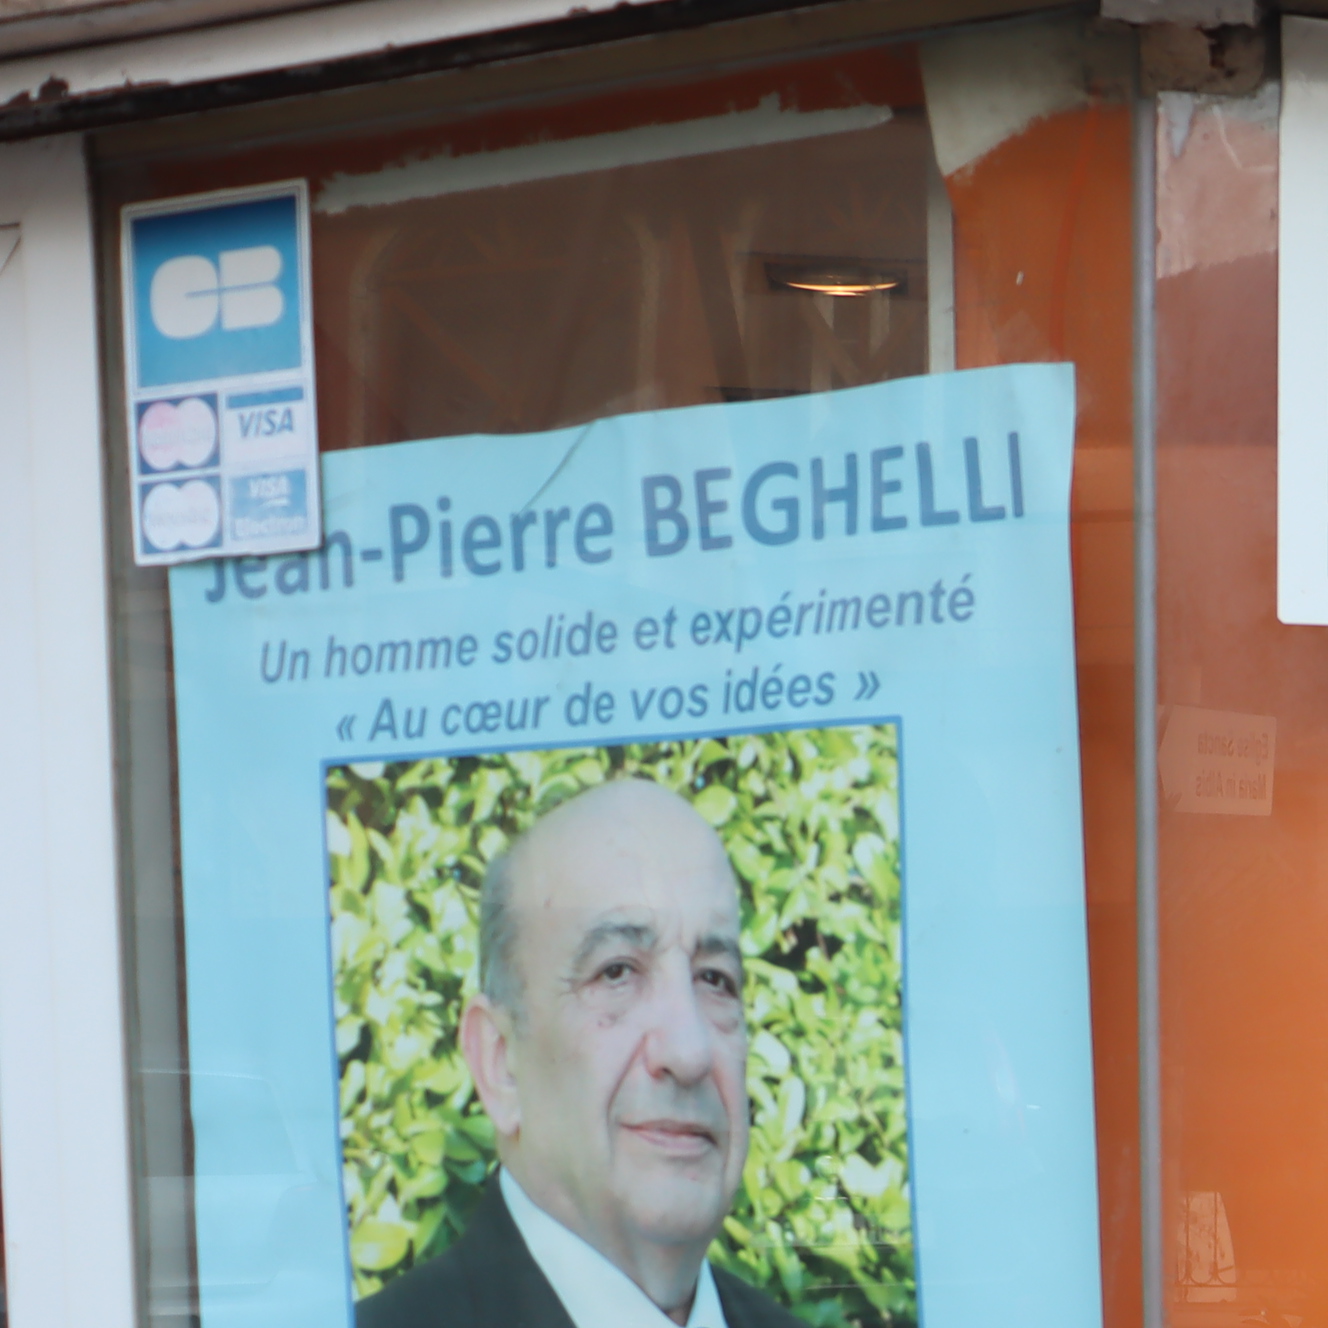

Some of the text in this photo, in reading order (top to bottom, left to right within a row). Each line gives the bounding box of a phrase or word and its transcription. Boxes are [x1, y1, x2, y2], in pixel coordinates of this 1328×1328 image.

[150, 245, 285, 339] CB
[238, 408, 295, 439] VISA
[205, 431, 1026, 603] Jean-Pierre BEGHELLI
[260, 573, 977, 683] Un homme solide et expérimenté
[369, 699, 427, 741] Au
[441, 695, 549, 736] cœur
[564, 682, 615, 726] de
[632, 682, 708, 721] vos
[723, 664, 835, 714] idées
